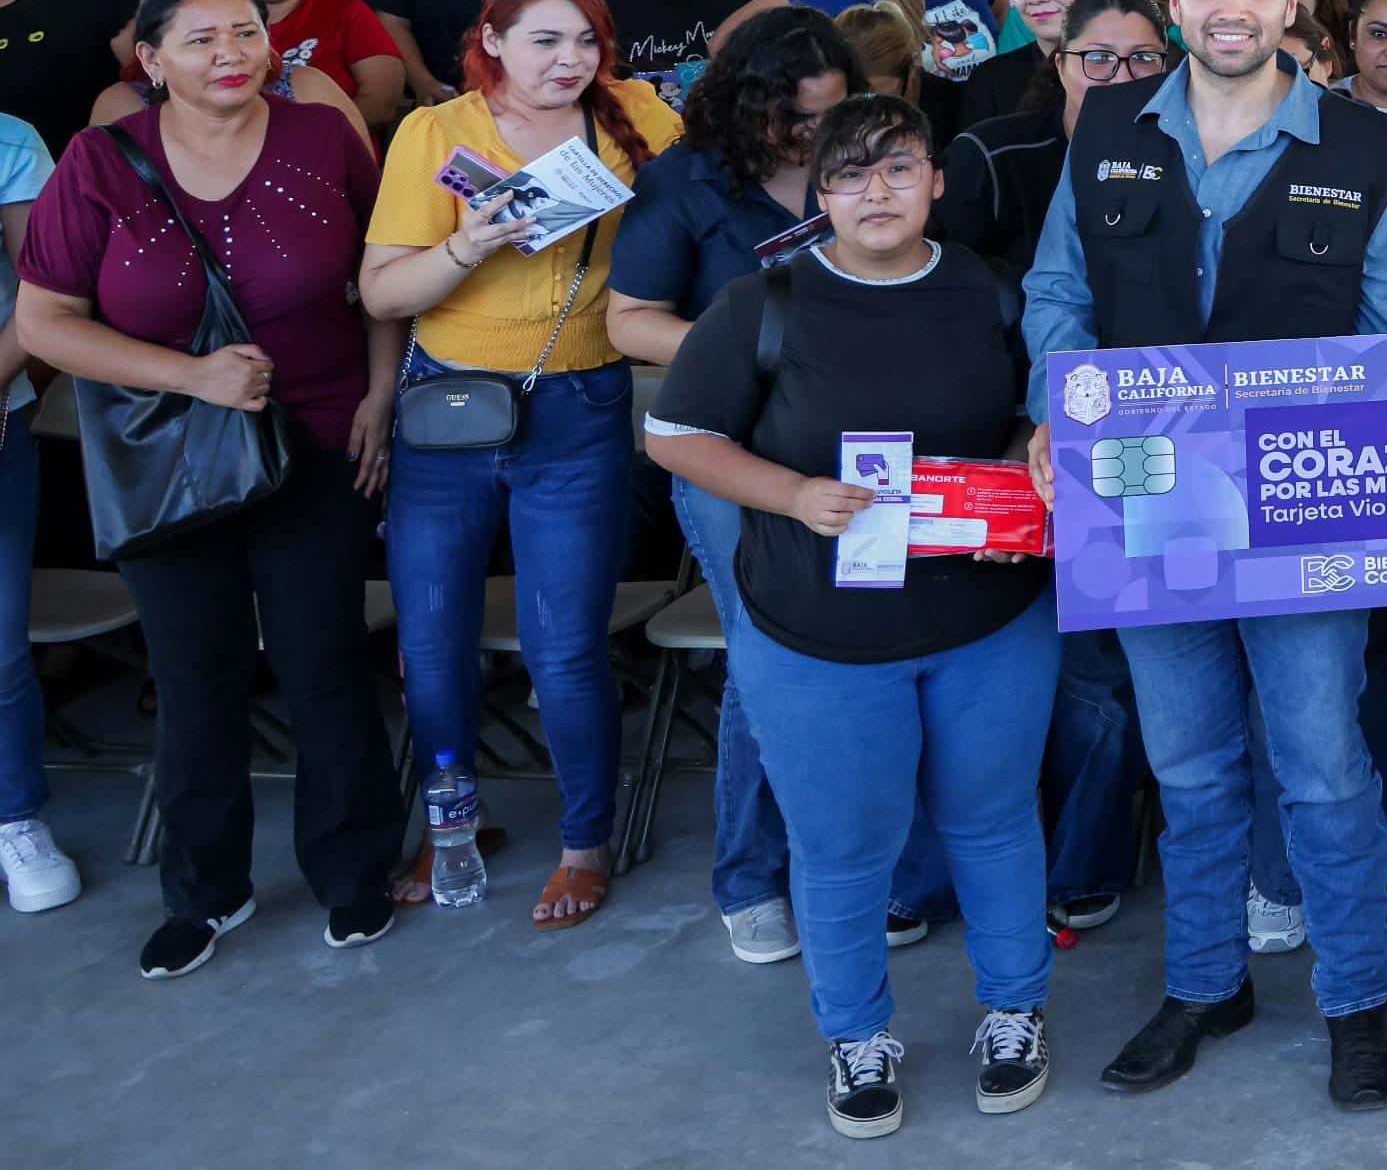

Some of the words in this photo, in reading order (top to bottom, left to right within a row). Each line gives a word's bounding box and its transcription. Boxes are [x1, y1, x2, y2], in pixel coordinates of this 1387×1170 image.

[629, 35, 687, 62] Mickey
[559, 150, 571, 162] de
[569, 161, 583, 175] las
[582, 173, 615, 204] Mujeres
[1289, 185, 1361, 202] BIENESTAR
[1117, 366, 1187, 388] BAJA
[1233, 365, 1366, 387] BIENESTAR
[1117, 385, 1216, 401] CALIFORNIA
[1235, 387, 1291, 399] Secretaría
[1295, 386, 1309, 396] de
[1312, 383, 1365, 395] Bienestar
[1118, 407, 1162, 416] GOBIERNO
[1166, 405, 1180, 414] DEL
[1183, 403, 1217, 412] ESTADO
[1258, 431, 1313, 452] CON
[1318, 429, 1345, 448] EL
[1261, 480, 1311, 501] POR
[1317, 478, 1360, 497] LAS
[1261, 501, 1343, 526] Tarjeta
